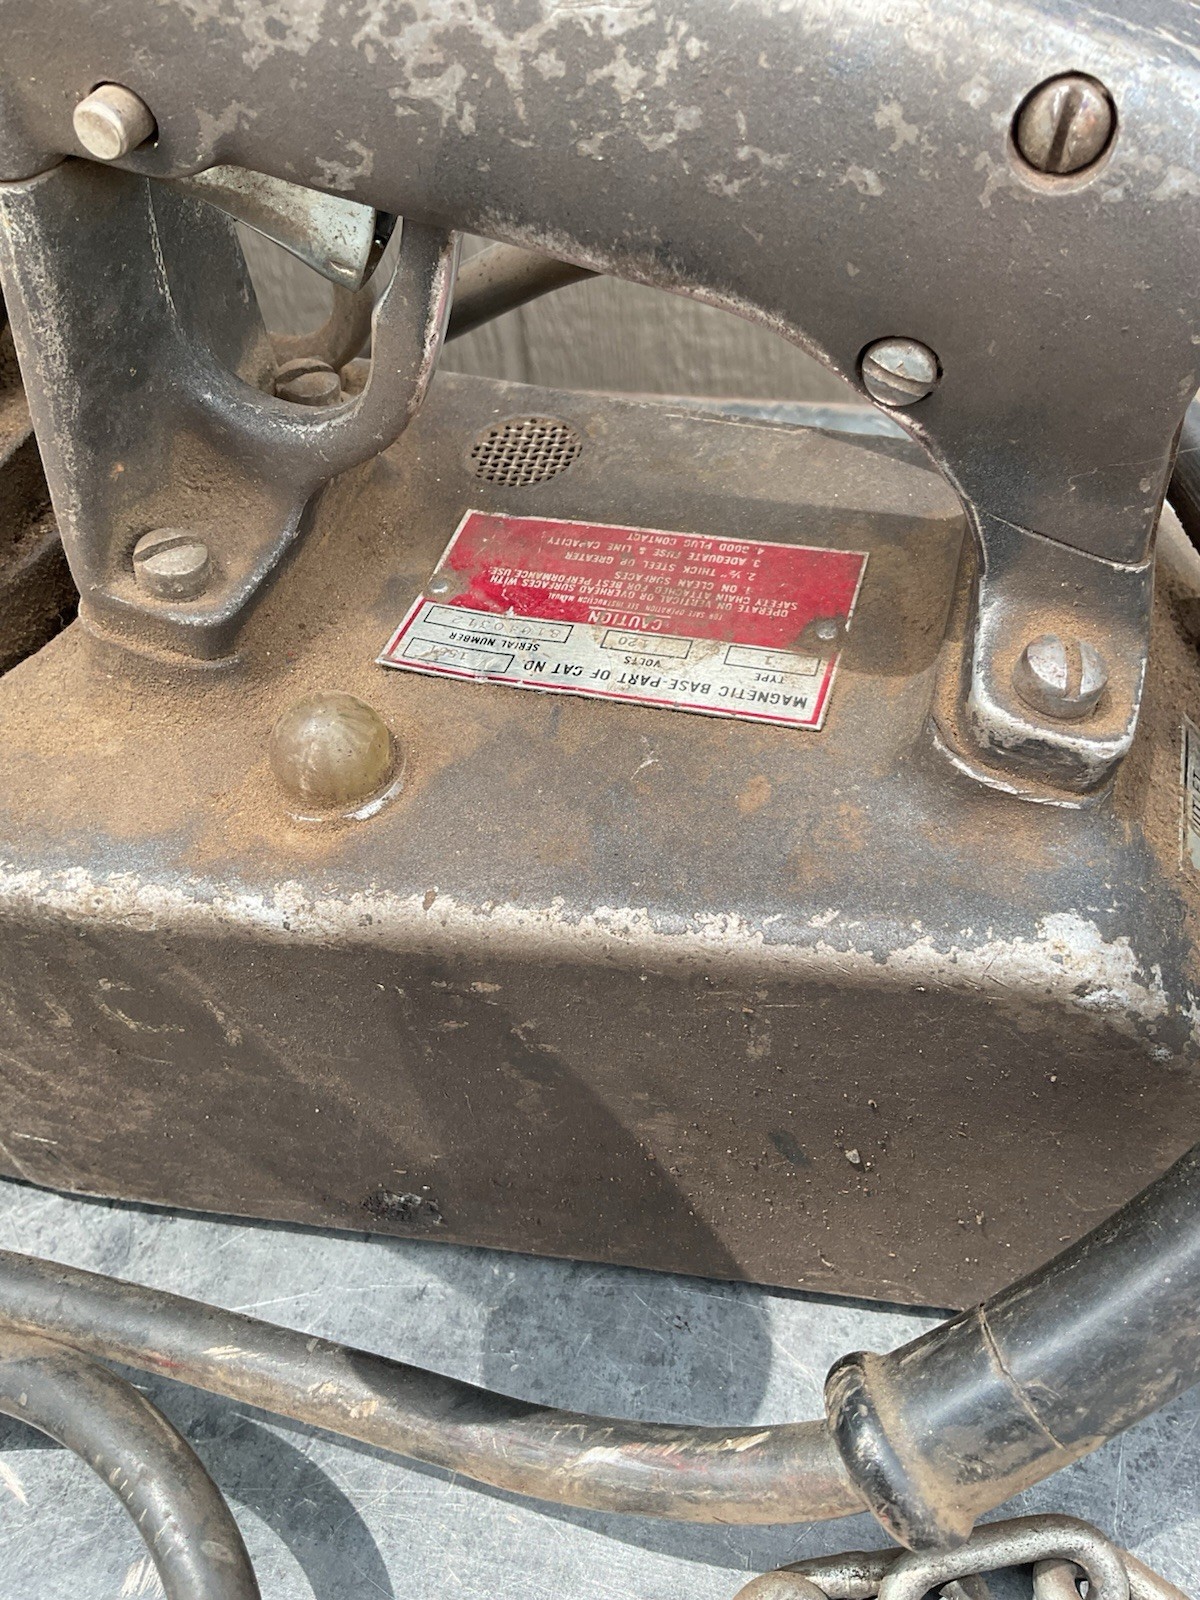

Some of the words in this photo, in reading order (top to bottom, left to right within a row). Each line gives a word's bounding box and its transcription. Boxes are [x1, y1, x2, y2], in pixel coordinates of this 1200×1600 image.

[546, 535, 601, 549] CAPACITY
[625, 532, 678, 545] CONTACT
[682, 538, 713, 549] PLUG
[605, 542, 632, 552] LINE
[652, 548, 682, 558] FUSE
[563, 551, 614, 564] GREATER
[686, 551, 747, 566] ADEQUATE
[640, 560, 677, 571] STEEL
[681, 564, 717, 576] THICK
[488, 574, 519, 586] WITH
[595, 578, 623, 589] BEST
[612, 570, 671, 585] SURFACES
[676, 578, 715, 590] CLEAN
[519, 578, 576, 593] SURFACES
[577, 584, 636, 599] OVERHEAD
[625, 582, 648, 592] FOR
[545, 591, 575, 603] MANUAL
[657, 594, 712, 608] VERTICAL
[714, 592, 751, 604] CHAIN
[754, 597, 798, 610] SAFETY
[736, 603, 789, 618] OPERATE
[586, 610, 663, 631] CAUTION
[447, 631, 496, 645] NUMBER
[498, 638, 540, 652] SERIAL
[622, 654, 661, 668] VOLTS
[551, 662, 583, 677] CAT
[616, 670, 711, 696] BASE-PART
[753, 672, 785, 684] TYPE
[717, 685, 808, 709] MAGNETIC
